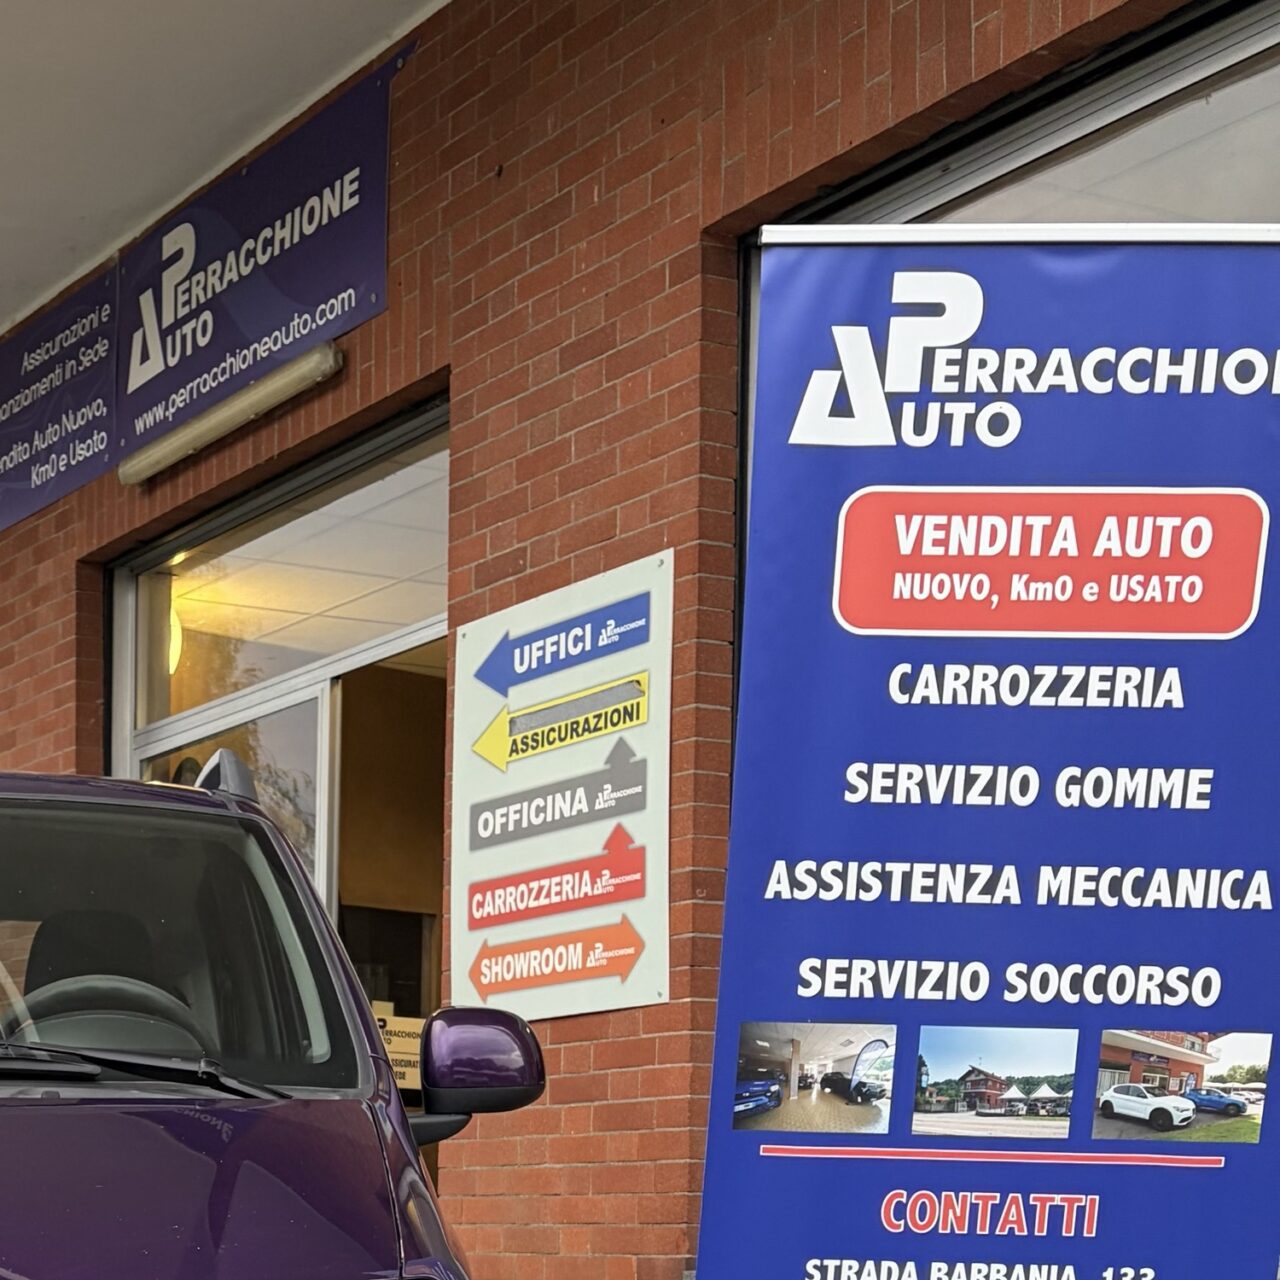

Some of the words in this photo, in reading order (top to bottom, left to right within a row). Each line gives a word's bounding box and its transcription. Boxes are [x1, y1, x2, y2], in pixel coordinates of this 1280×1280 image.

[162, 167, 360, 330] PERRACCHIONE
[21, 306, 100, 376] Assicurazioni
[100, 303, 111, 323] e
[64, 359, 77, 381] in
[78, 337, 110, 372] Sede
[126, 288, 214, 395] AUTO
[884, 271, 1280, 396] PERRACCHIO
[134, 286, 356, 436] www.perracchioneauto.com
[788, 326, 1022, 448] AUTO
[32, 422, 61, 455] Auto
[61, 398, 108, 437] Nuovo,
[58, 453, 67, 472] e
[70, 430, 108, 466] Usato
[894, 514, 1079, 558] VENDITA
[1092, 516, 1214, 559] AUTO
[892, 572, 1000, 610] NUOVO,
[1082, 582, 1100, 602] e
[1108, 575, 1204, 603] USATO
[514, 623, 592, 674] UFFICI
[888, 663, 1185, 709] CARROZZERIA
[508, 701, 640, 758] ASSICURAZIONI
[844, 762, 1040, 806] SERVIZIO
[1055, 766, 1214, 810] GOMME
[477, 786, 589, 838] OFFICINA
[472, 869, 593, 919] CARROZZERIA
[764, 860, 1022, 905] ASSISTENZA
[1037, 866, 1273, 910] MECCANICA
[480, 942, 583, 985] SHOWROOM
[797, 957, 990, 1001] SERVIZIO
[1003, 963, 1222, 1008] SOCCORSO
[880, 1189, 1100, 1238] CONTATTI
